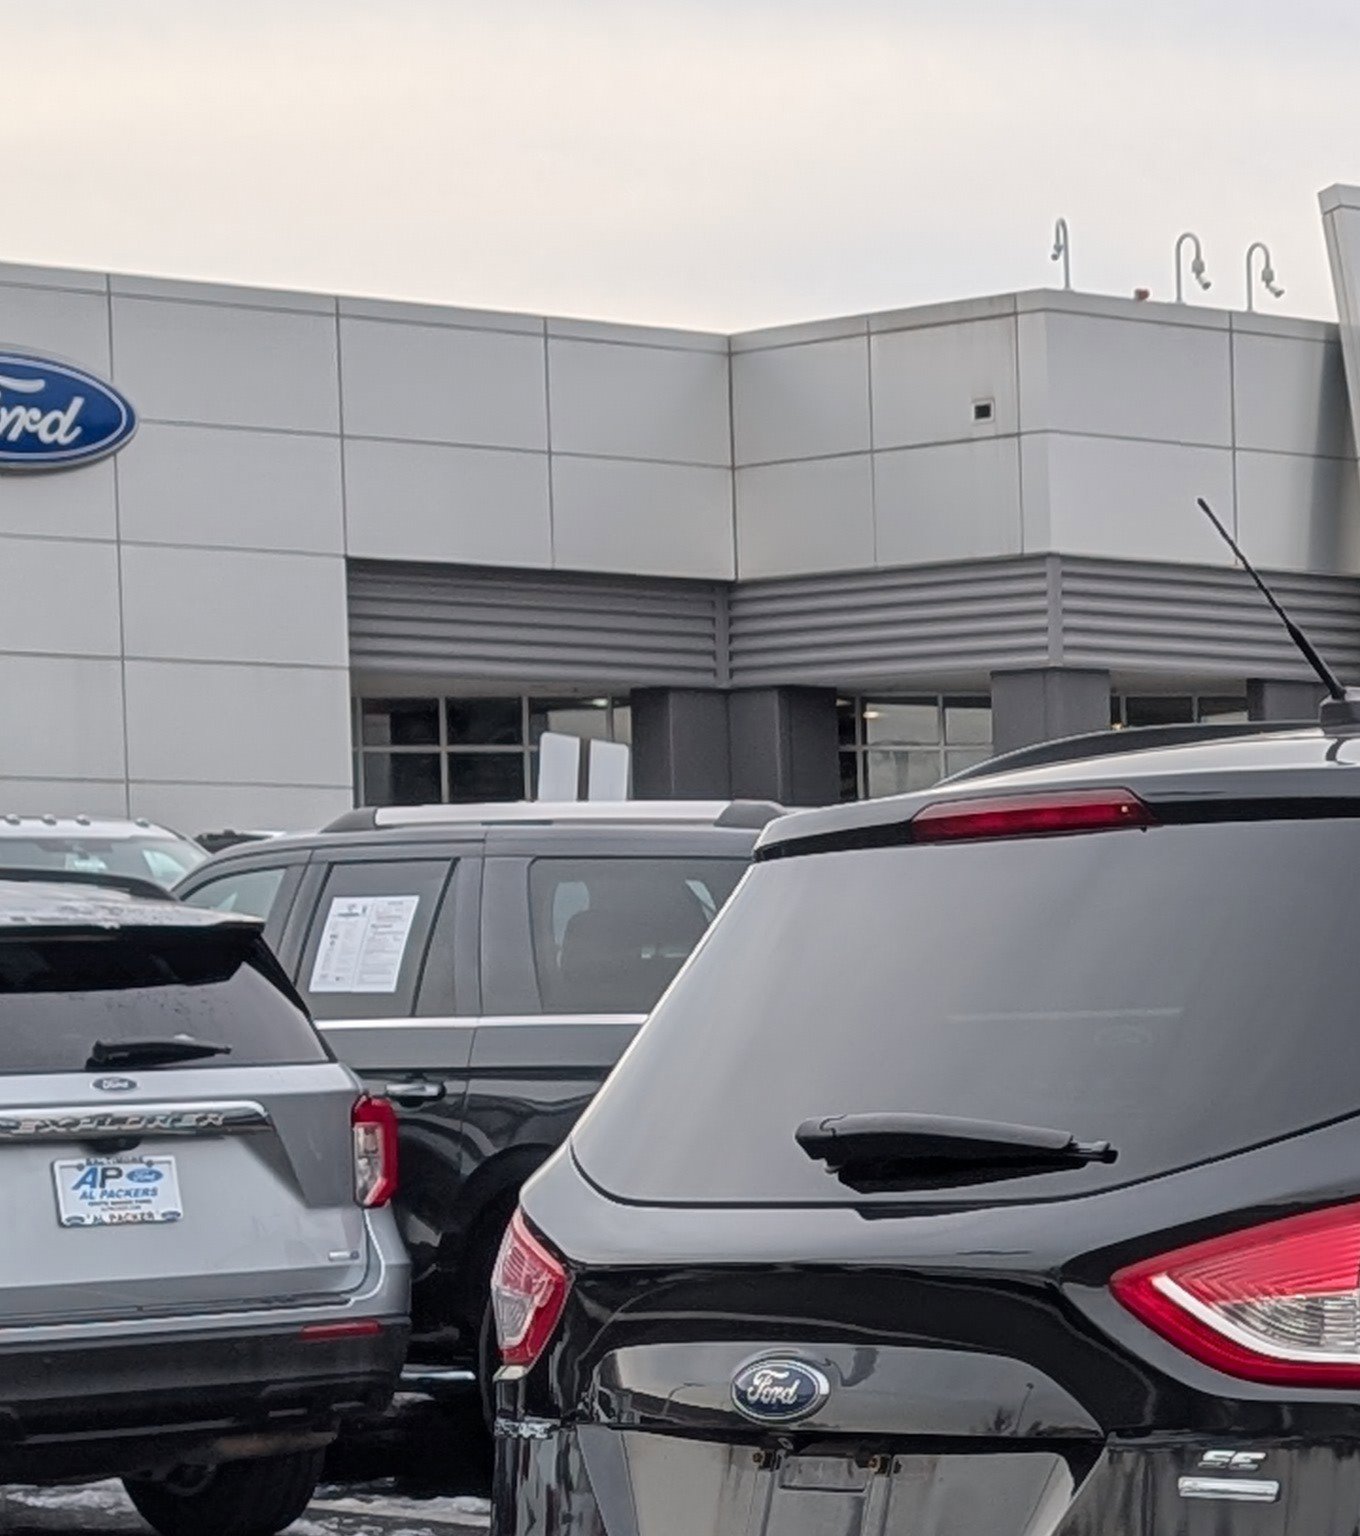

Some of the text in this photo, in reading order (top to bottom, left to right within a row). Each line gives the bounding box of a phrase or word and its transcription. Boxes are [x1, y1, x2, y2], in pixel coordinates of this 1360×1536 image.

[11, 1112, 225, 1135] EXPLORER
[71, 1166, 123, 1190] AP
[100, 1187, 159, 1199] PACKERS
[746, 1368, 801, 1405] Ford
[1198, 1450, 1266, 1470] SE
